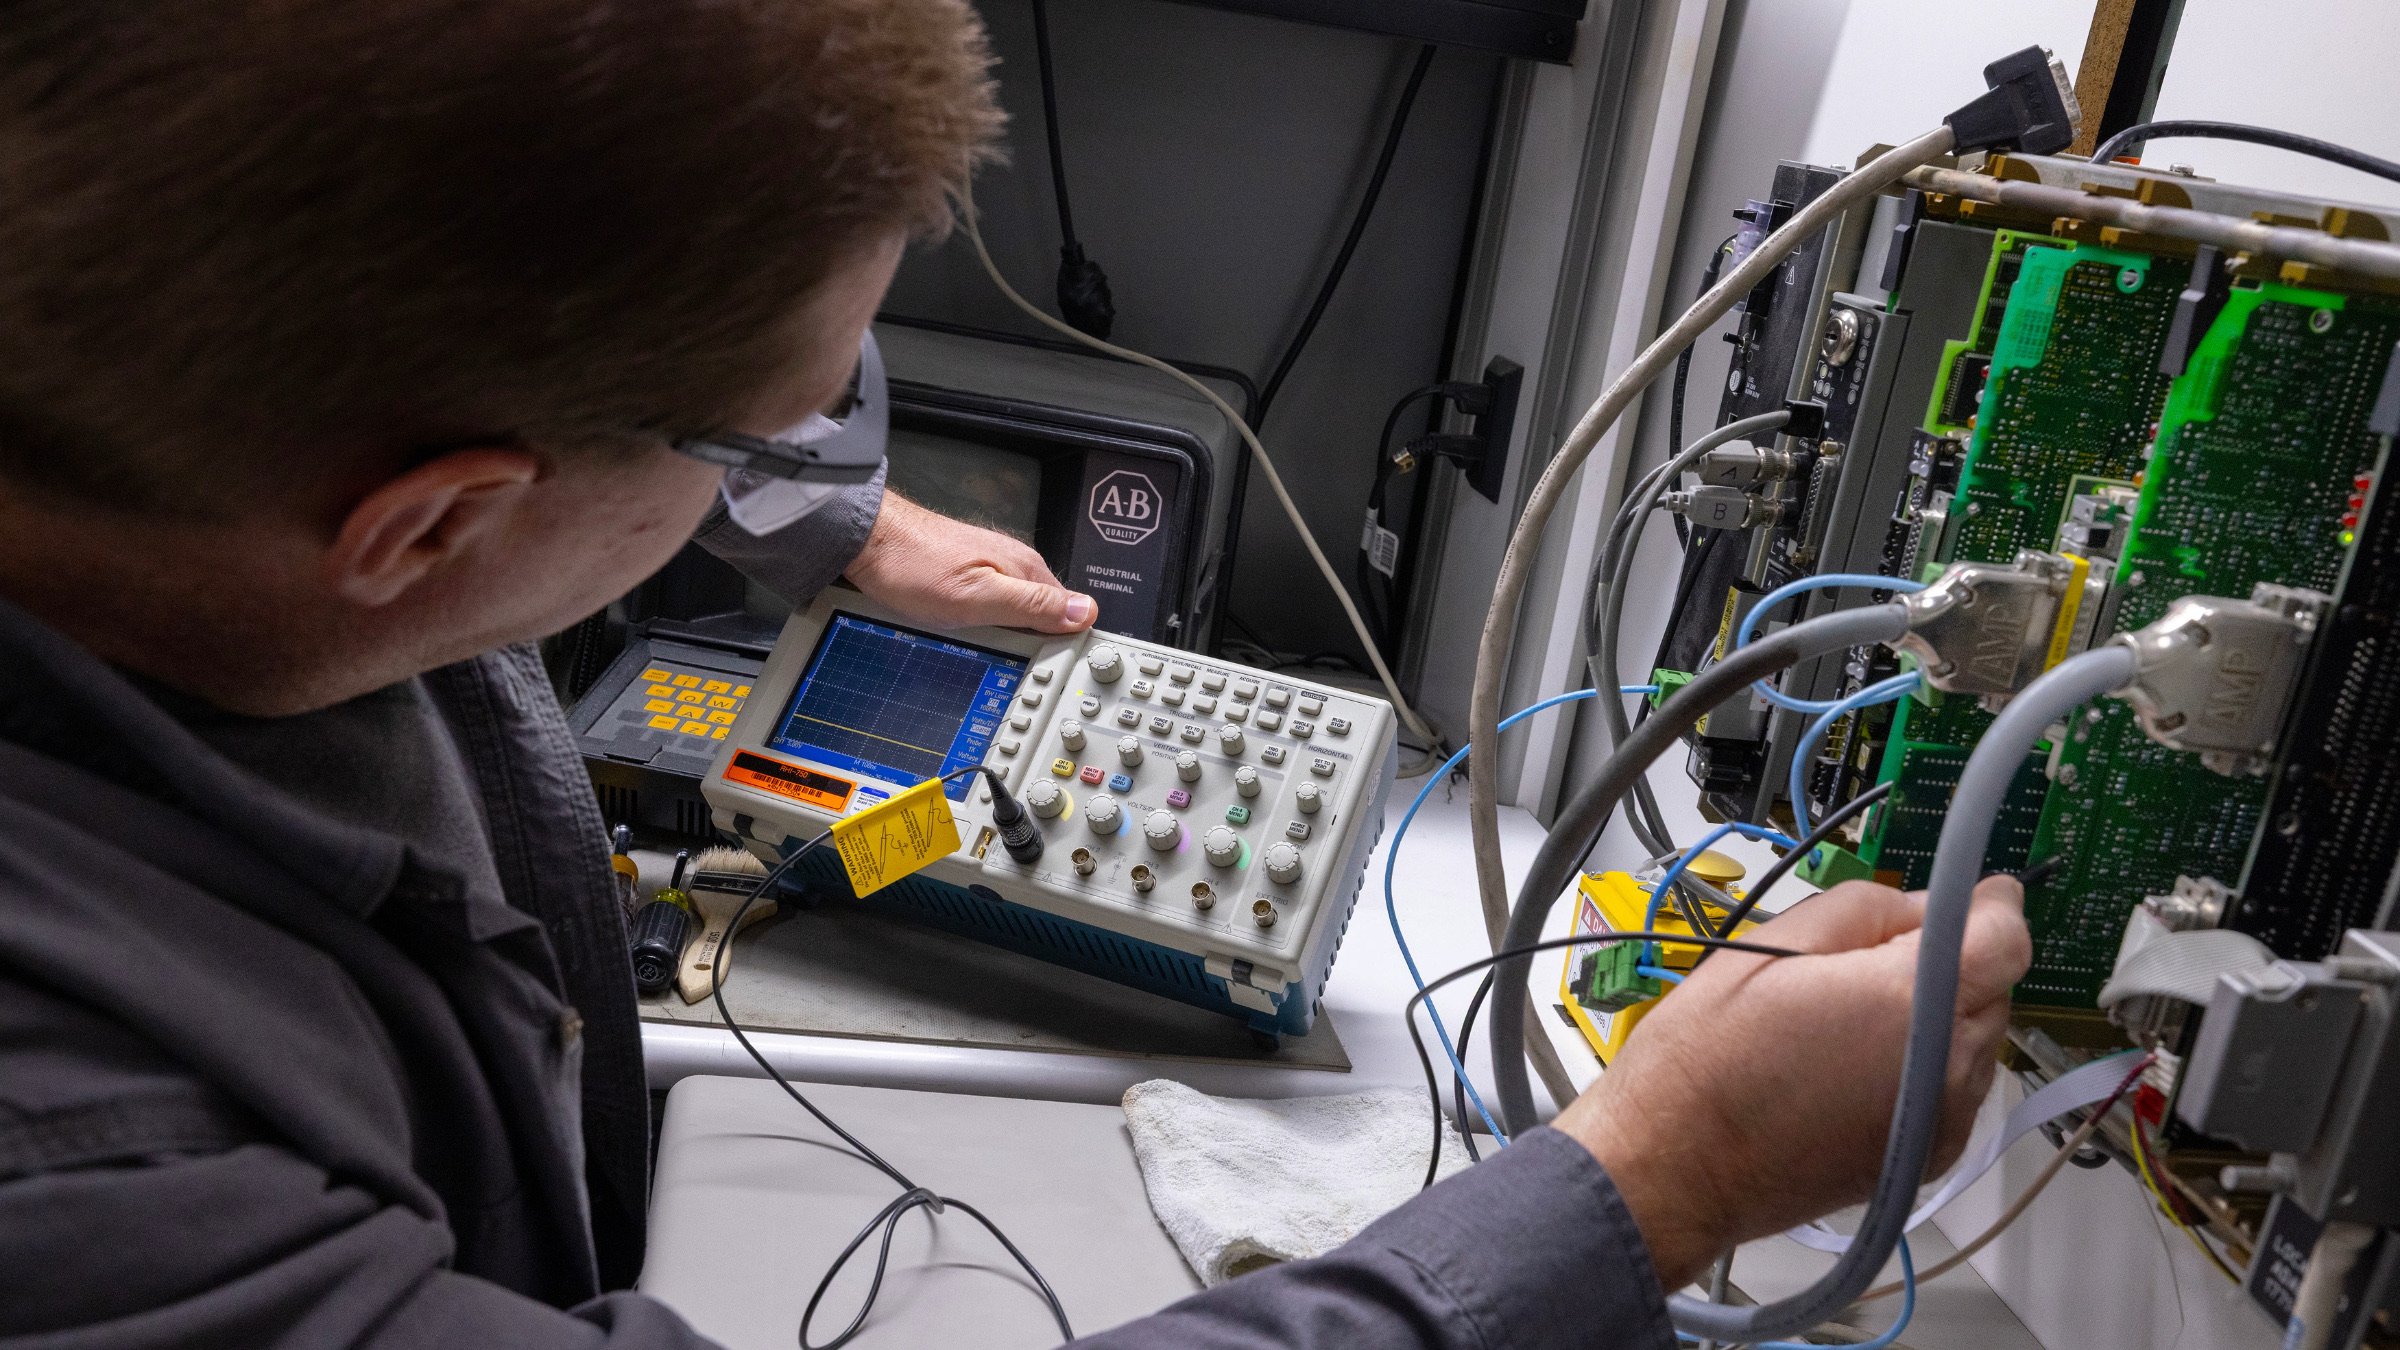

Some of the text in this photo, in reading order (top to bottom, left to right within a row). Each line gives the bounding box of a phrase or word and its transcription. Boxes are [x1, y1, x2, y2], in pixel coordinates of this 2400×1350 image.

[1721, 466, 1736, 479] A
[1098, 485, 1150, 520] A-B
[1714, 502, 1727, 520] B
[1106, 527, 1138, 540] QUALITY
[1086, 564, 1142, 582] INDUSTRIAL
[1088, 579, 1134, 594] TERMINAL
[836, 615, 850, 626] Tek
[902, 632, 916, 641] Auto
[1142, 652, 1170, 662] AUTORANGE
[1172, 660, 1202, 670] SAVE/RECALL
[995, 670, 1018, 682] Coupling
[1207, 668, 1230, 677] MEASURE
[1303, 692, 1327, 701] AUTOSET
[1169, 709, 1196, 720] TRIGGER
[967, 738, 982, 747] Probe
[958, 751, 979, 761] Voltage
[1308, 745, 1349, 759] HORIZONTAL
[1083, 770, 1097, 779] MENU
[838, 837, 856, 876] WARNING
[1272, 897, 1288, 906] TRIG
